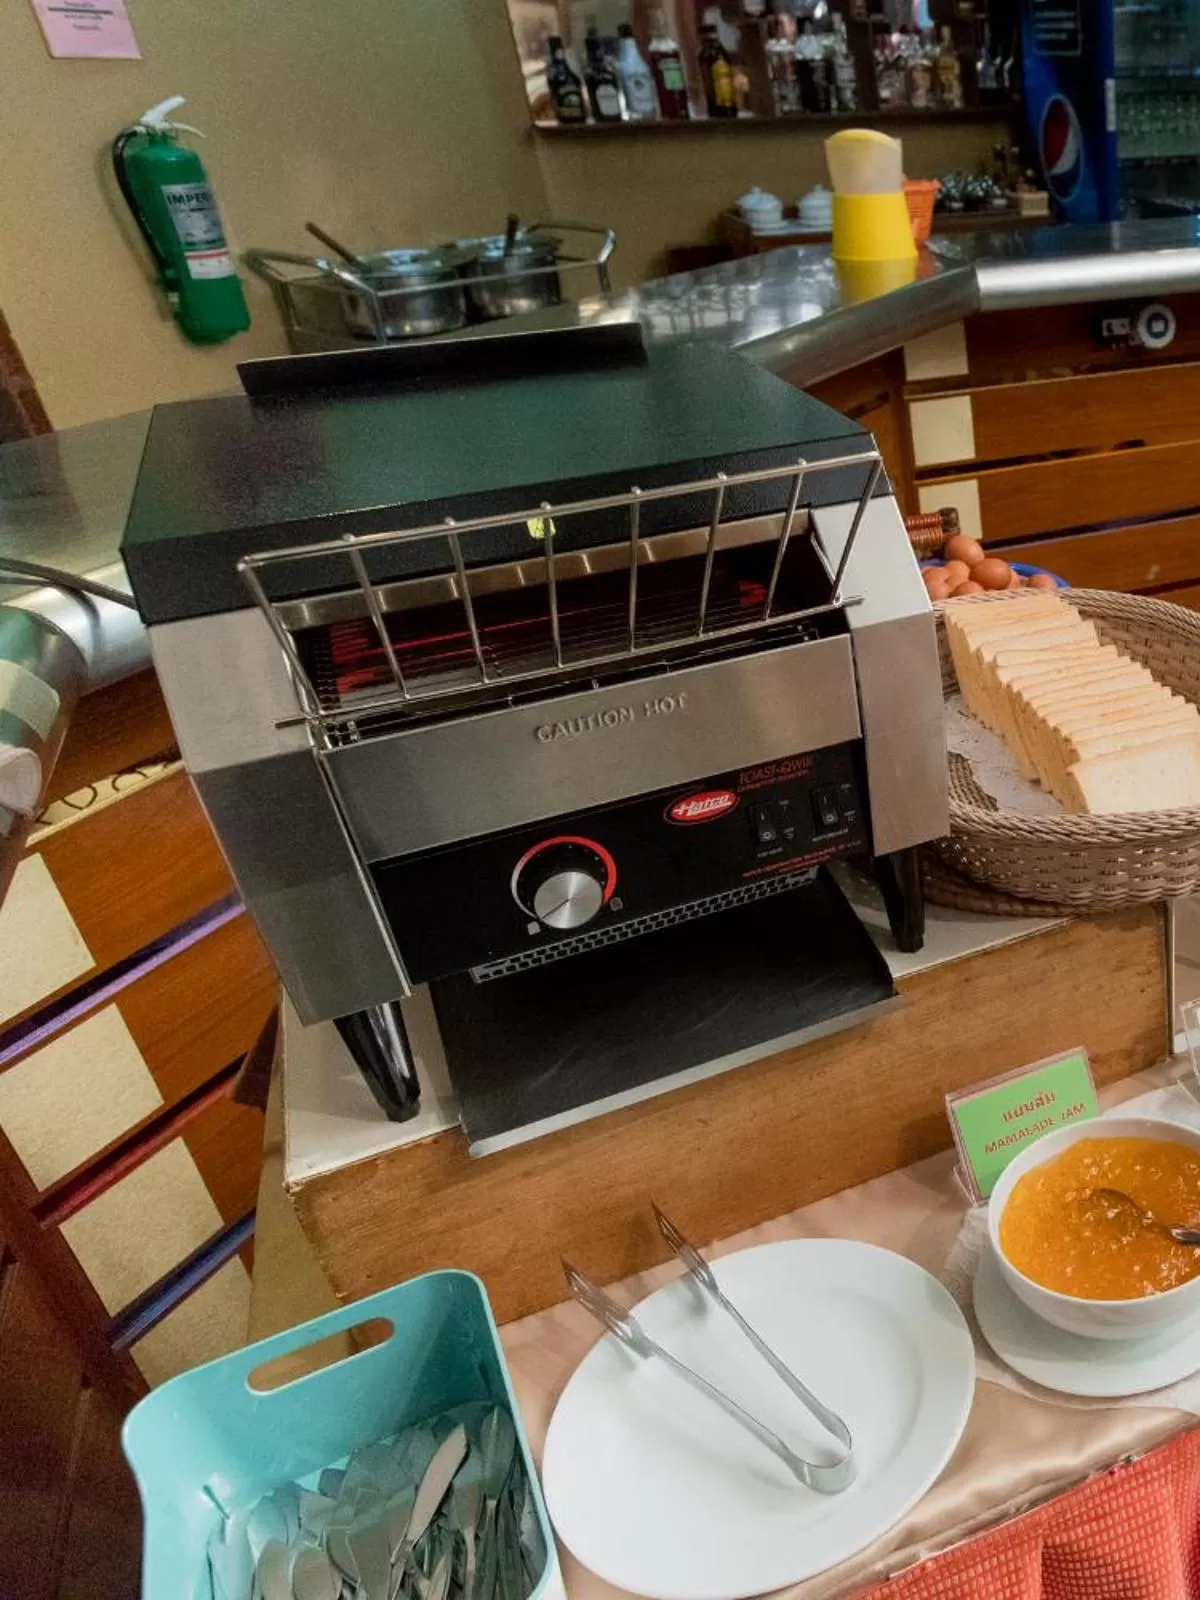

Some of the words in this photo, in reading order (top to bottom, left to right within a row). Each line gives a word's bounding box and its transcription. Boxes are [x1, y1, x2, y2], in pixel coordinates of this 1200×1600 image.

[534, 706, 634, 743] CAUTION
[643, 691, 687, 718] HOT
[672, 794, 734, 817] Hatco
[983, 1117, 1057, 1153] MAMALADE
